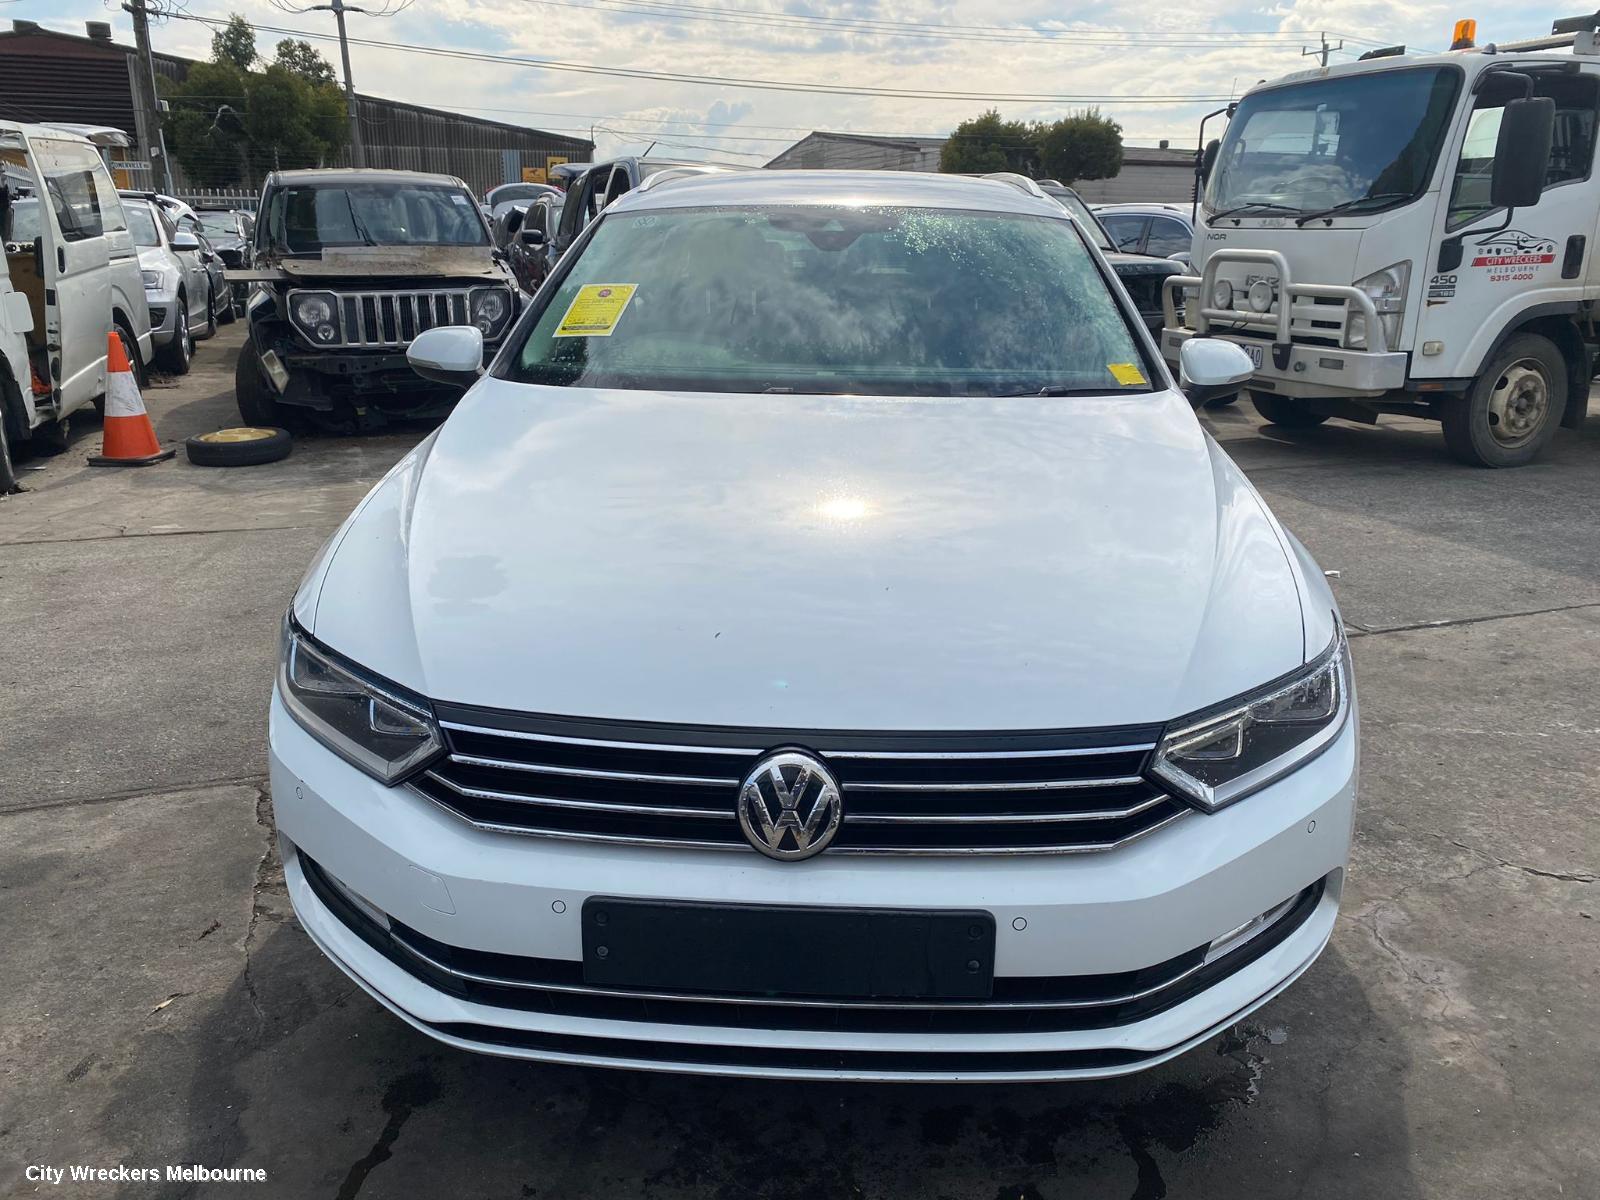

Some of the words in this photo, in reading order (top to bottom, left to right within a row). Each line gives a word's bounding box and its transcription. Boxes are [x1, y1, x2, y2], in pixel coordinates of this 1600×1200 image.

[1486, 257, 1503, 265] CITY
[1504, 255, 1542, 264] WRECKERS
[1487, 265, 1540, 273] MELBOURNE
[1430, 274, 1458, 285] 450
[1490, 274, 1511, 282] 9315
[1512, 273, 1534, 281] 4000
